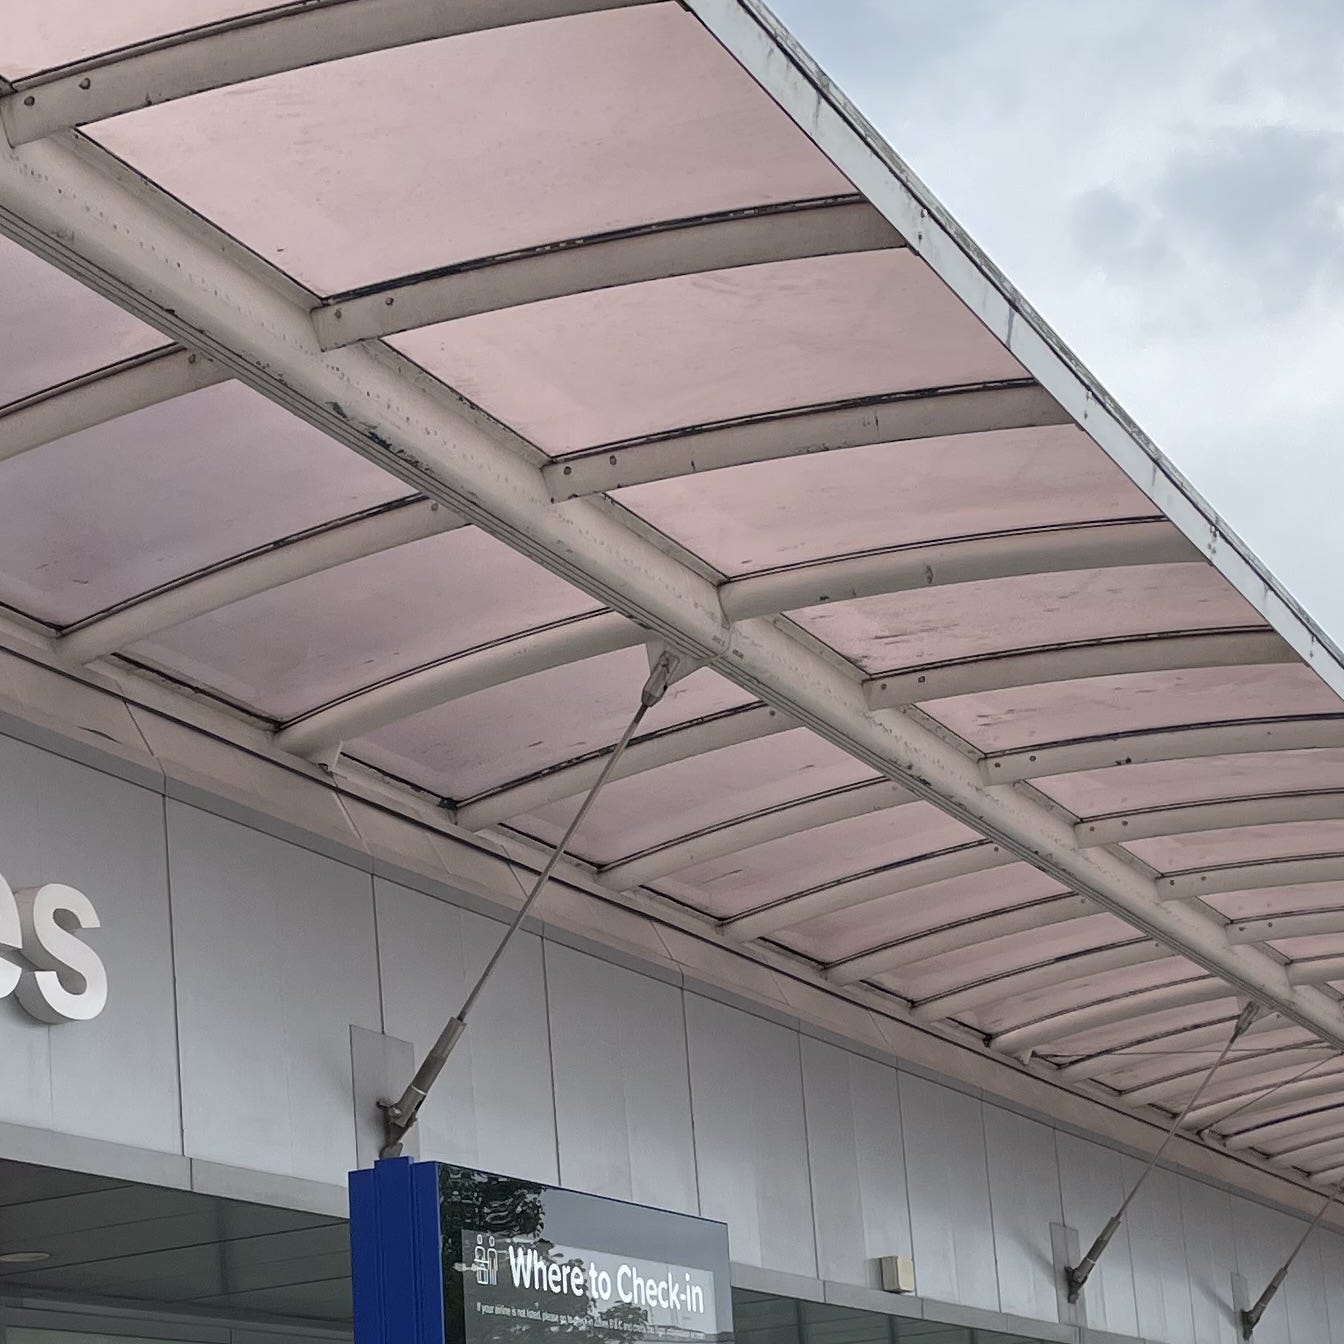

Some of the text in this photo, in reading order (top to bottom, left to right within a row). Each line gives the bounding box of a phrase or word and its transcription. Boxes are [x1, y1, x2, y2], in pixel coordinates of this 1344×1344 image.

[508, 1245, 704, 1313] Where to Check-in
